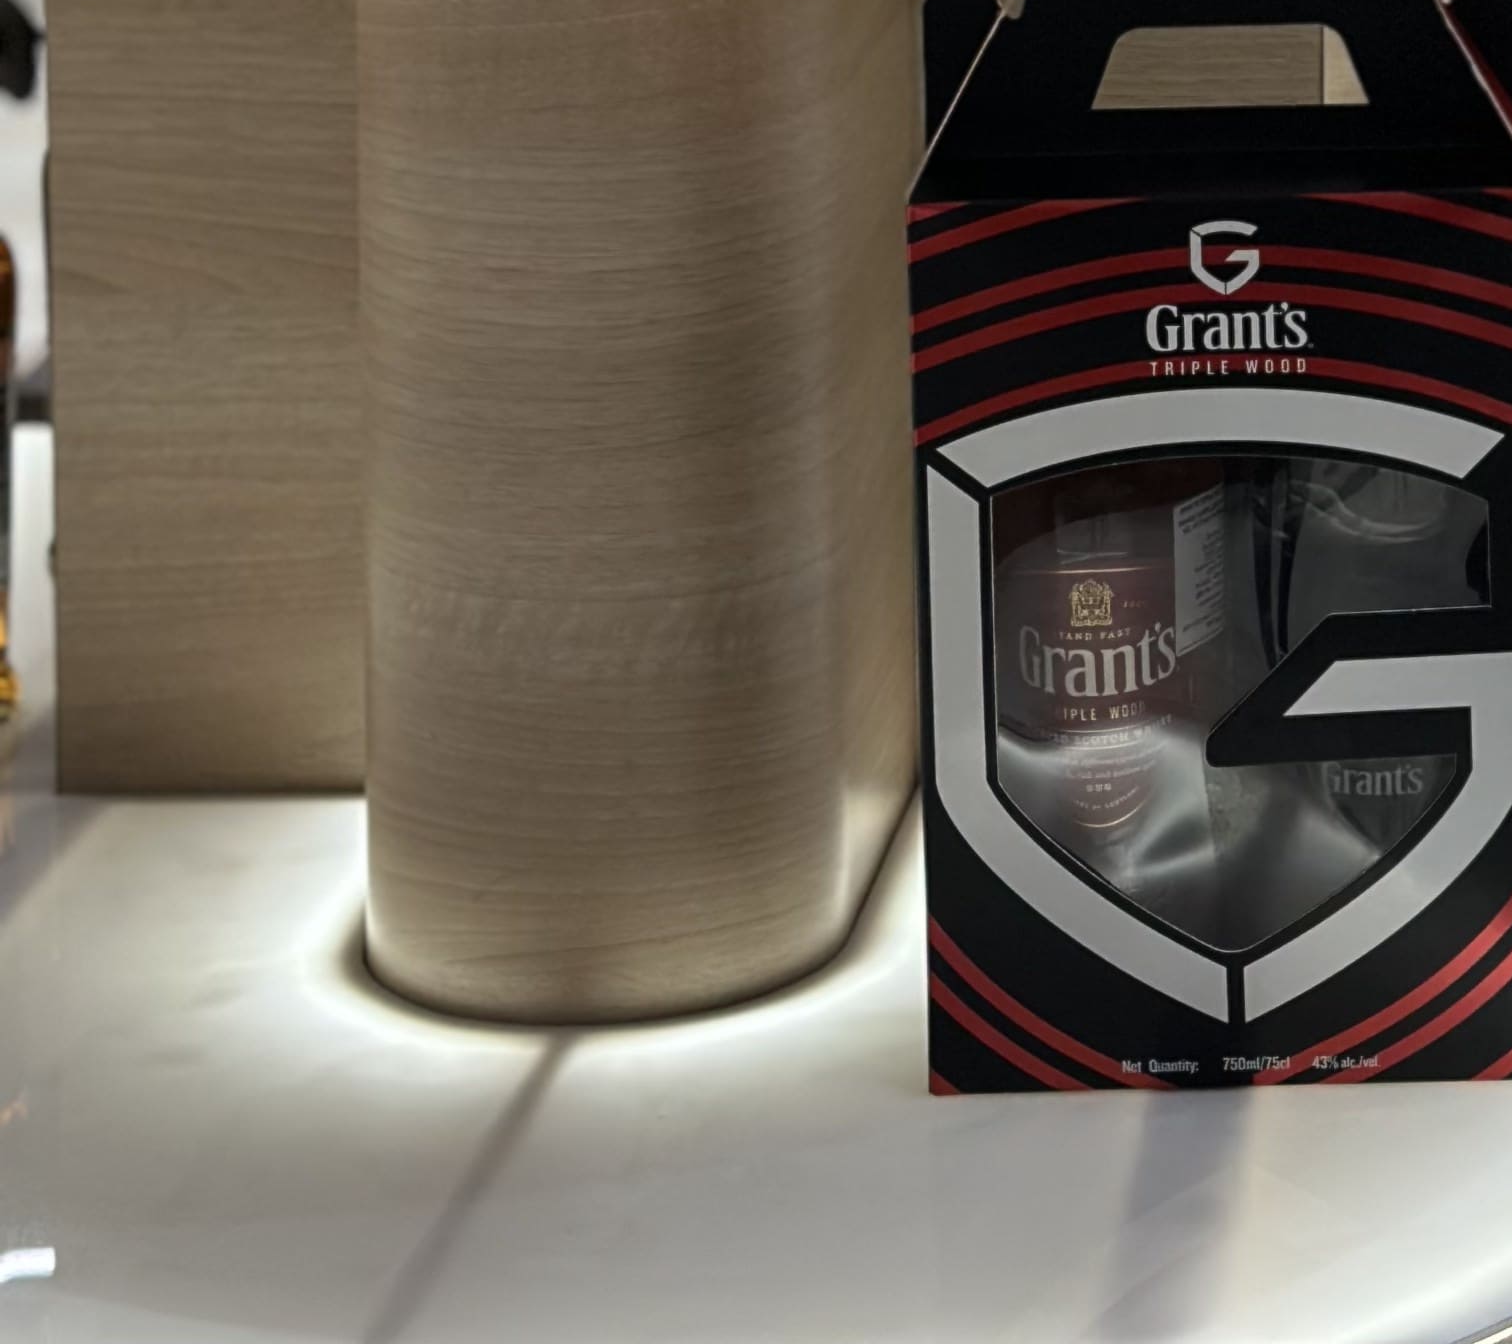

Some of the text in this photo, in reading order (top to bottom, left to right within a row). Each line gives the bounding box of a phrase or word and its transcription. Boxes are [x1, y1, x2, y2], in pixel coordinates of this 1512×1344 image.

[1146, 301, 1308, 352] Grant's
[1149, 358, 1307, 377] TRIPLE WOOD
[1059, 631, 1093, 641] TAND
[1019, 621, 1177, 698] Grant's
[1063, 708, 1097, 721] IPLE
[1321, 762, 1423, 796] Grant's
[1121, 1060, 1143, 1074] Net
[1149, 1059, 1199, 1074] Quantity:
[1223, 1056, 1291, 1071] 750ml/75cl
[1312, 1055, 1339, 1070] 43%
